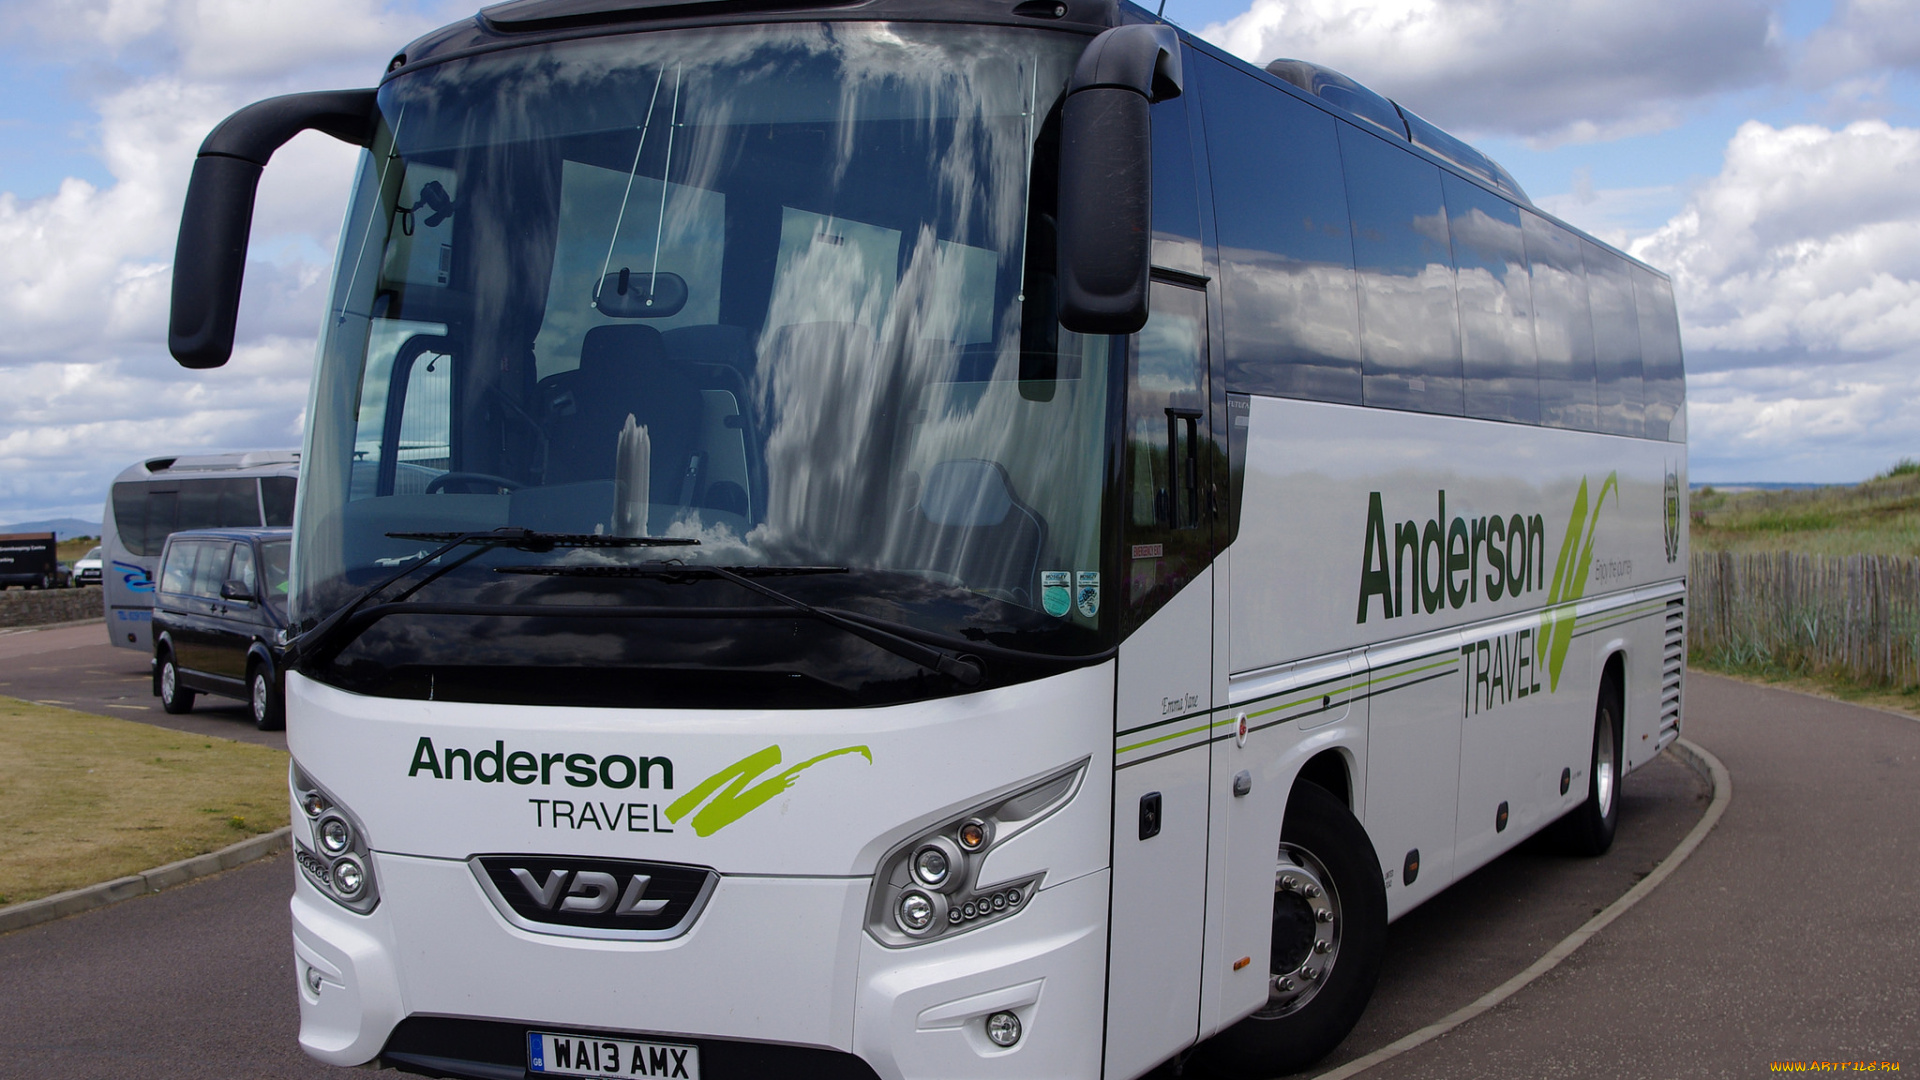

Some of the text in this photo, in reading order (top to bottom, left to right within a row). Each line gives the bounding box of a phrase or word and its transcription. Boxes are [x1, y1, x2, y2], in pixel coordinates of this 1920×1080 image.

[1356, 488, 1546, 625] Anderson
[1461, 626, 1542, 719] TRAVEL
[1161, 692, 1198, 715] Emma Jane
[408, 736, 674, 790] Anderson
[529, 798, 674, 834] TRAVEL
[509, 867, 671, 916] VDL
[533, 1058, 542, 1067] GB
[553, 1038, 690, 1079] WA13 AMX
